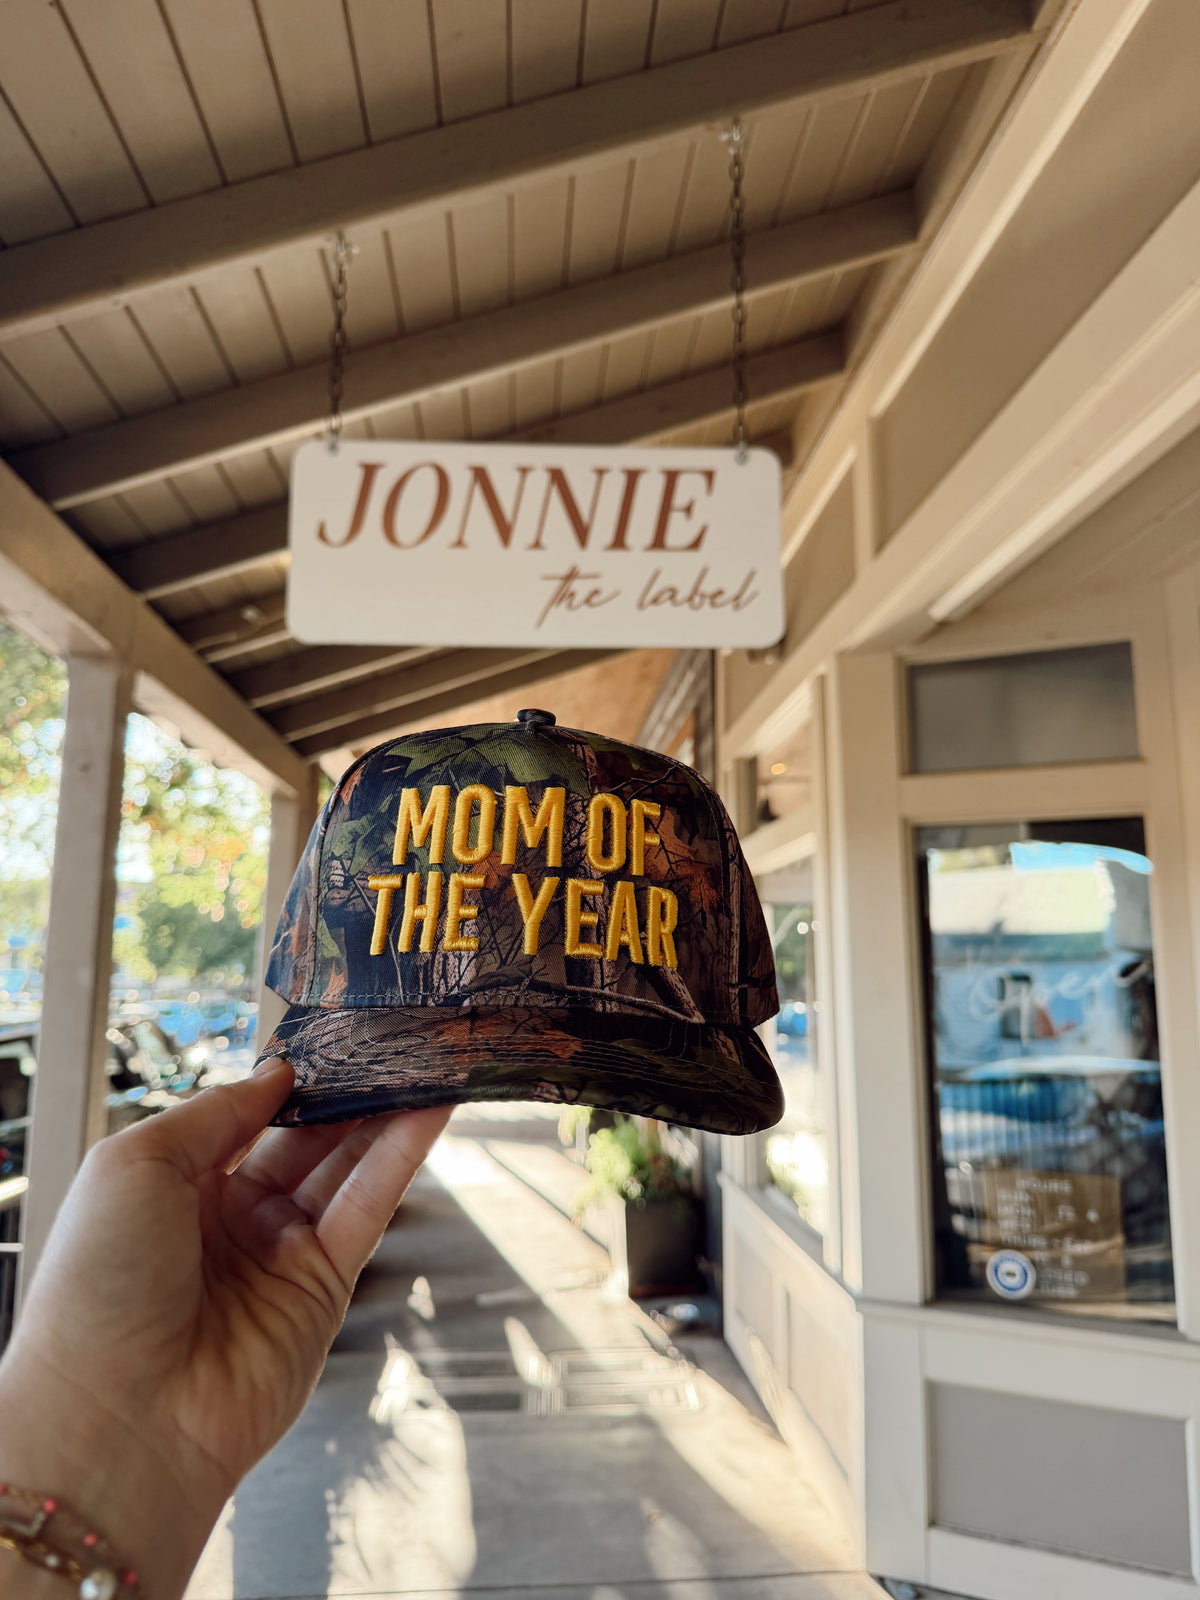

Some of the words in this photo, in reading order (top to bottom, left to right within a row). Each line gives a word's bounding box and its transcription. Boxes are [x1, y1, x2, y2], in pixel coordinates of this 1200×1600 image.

[316, 461, 717, 552] JONNIE
[534, 563, 620, 630] the
[636, 565, 758, 611] label
[392, 784, 566, 867] MOM
[585, 792, 661, 876] OF
[368, 871, 486, 956] THE
[511, 873, 679, 970] YEAR
